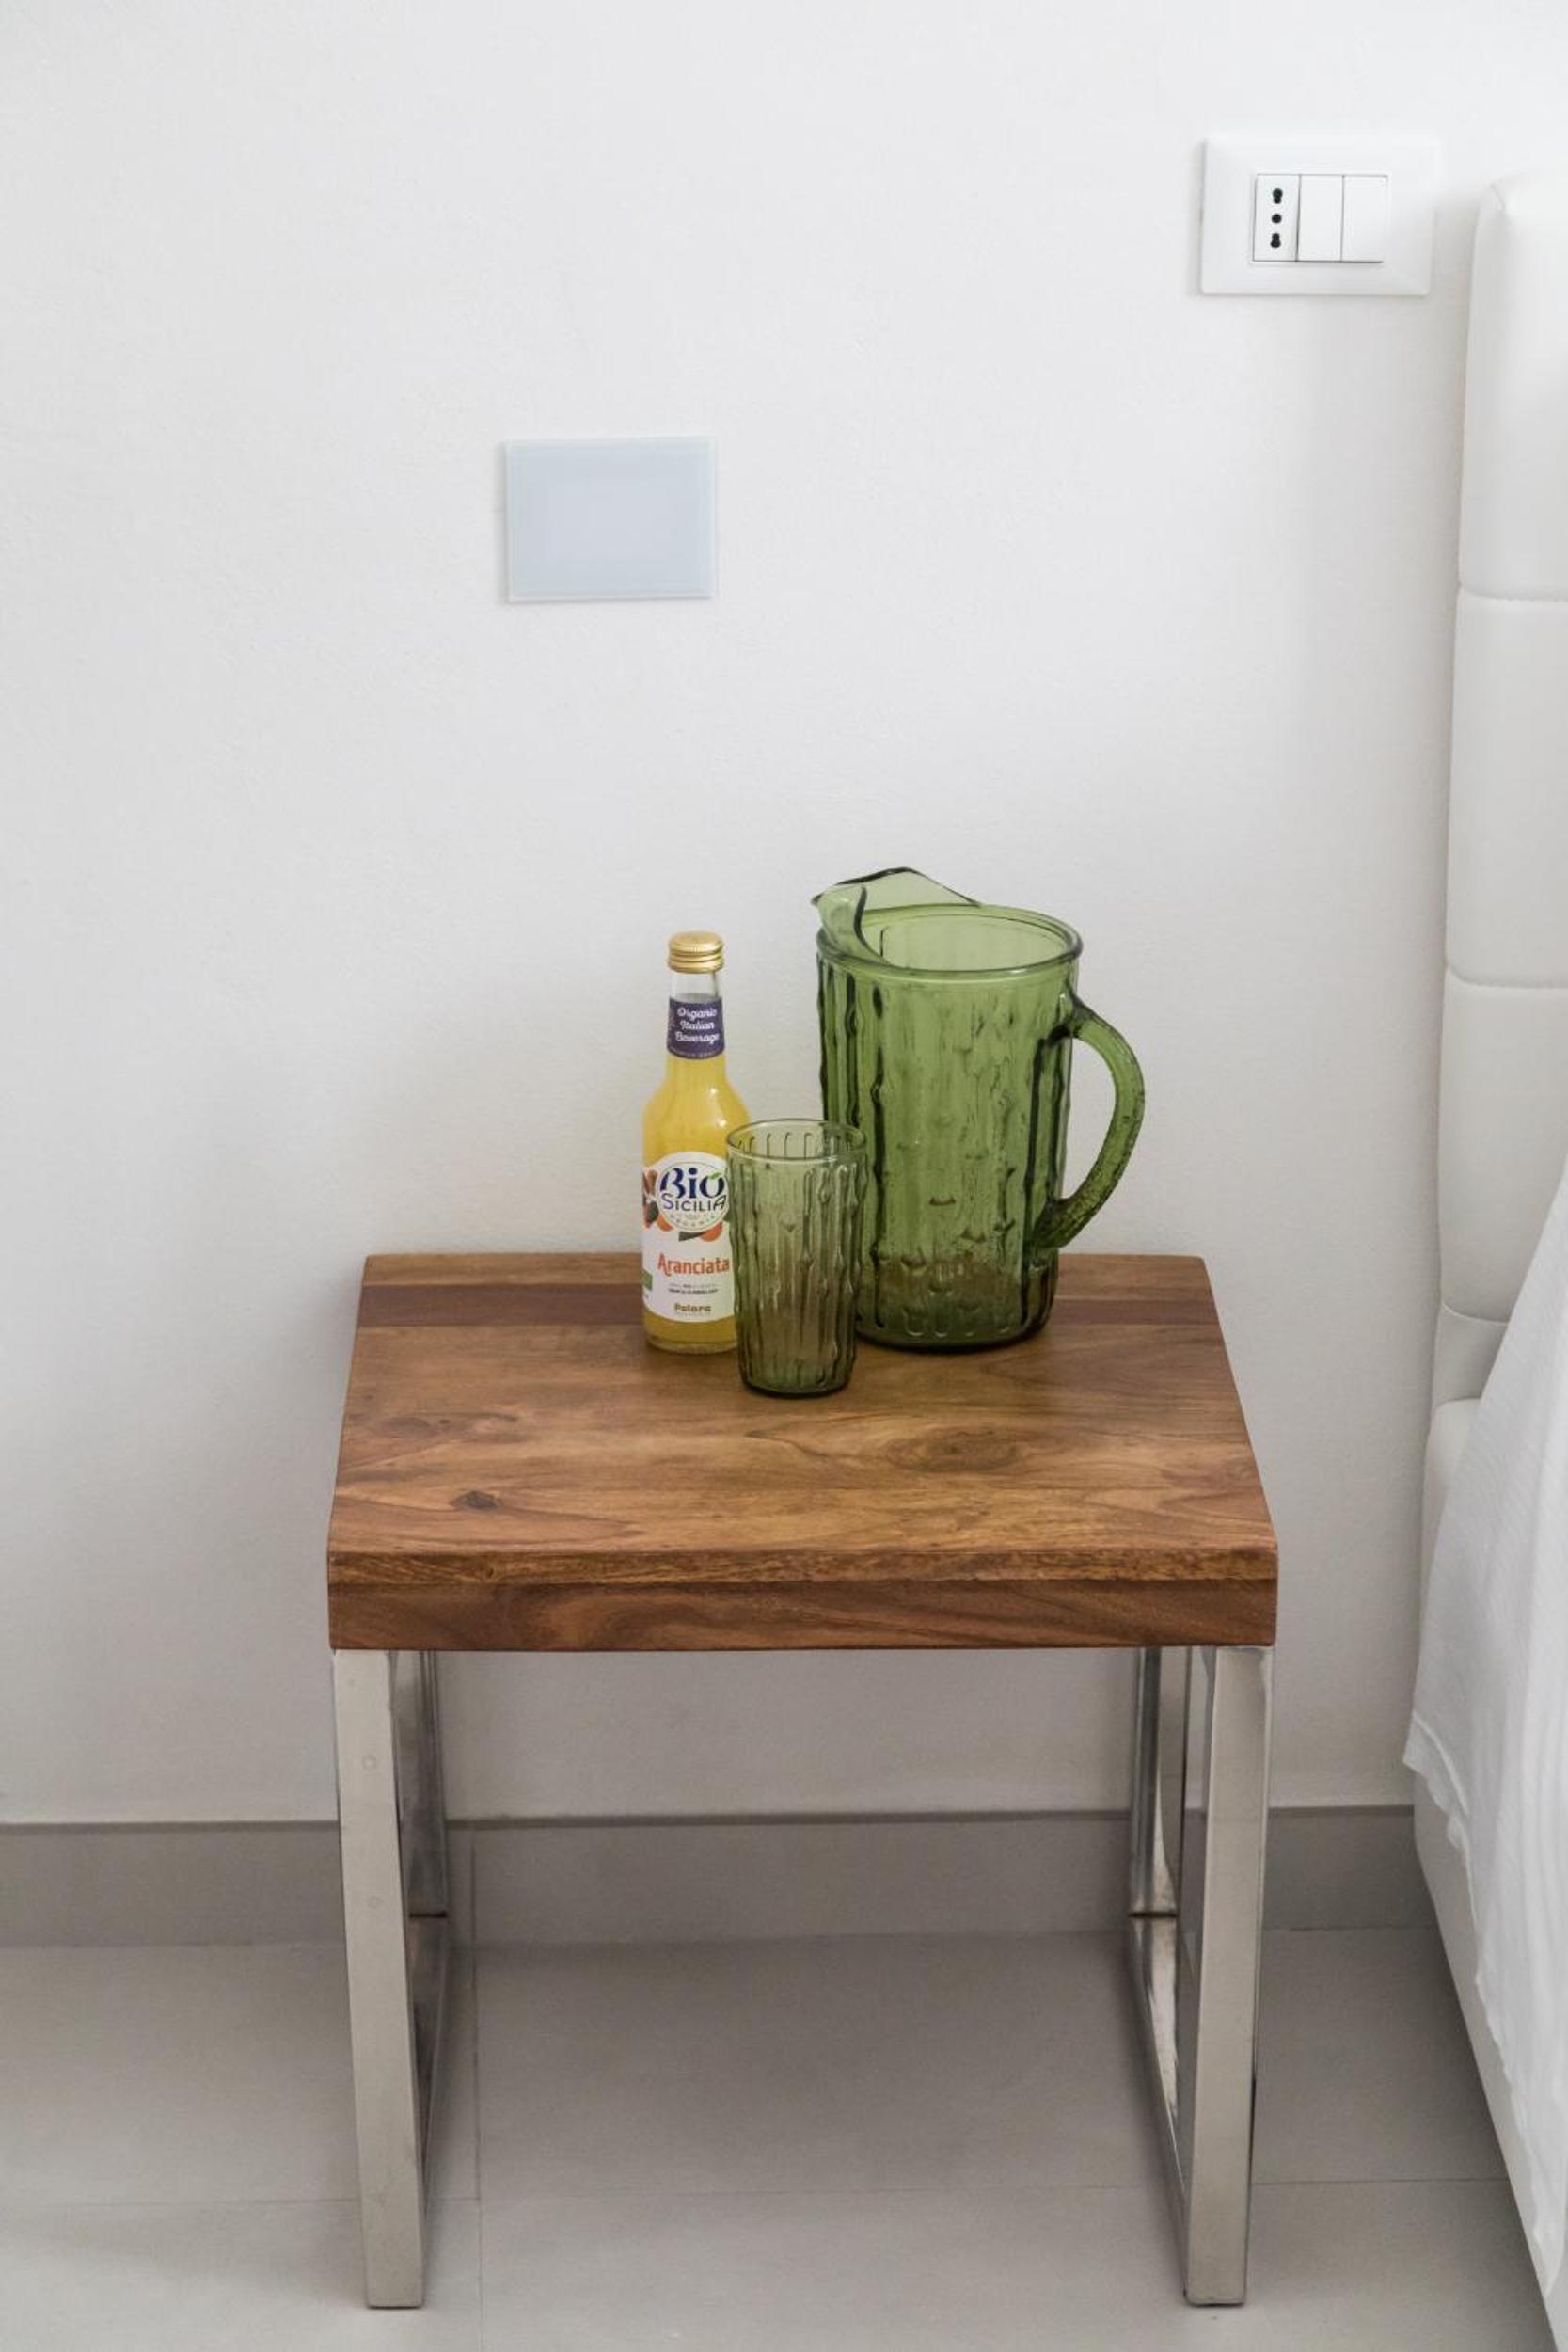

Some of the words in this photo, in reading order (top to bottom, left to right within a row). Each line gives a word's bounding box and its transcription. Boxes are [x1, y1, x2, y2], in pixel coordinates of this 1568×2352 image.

[677, 1007, 717, 1022] Organic
[675, 1031, 720, 1044] Beverage
[657, 1253, 730, 1277] Aranciata
